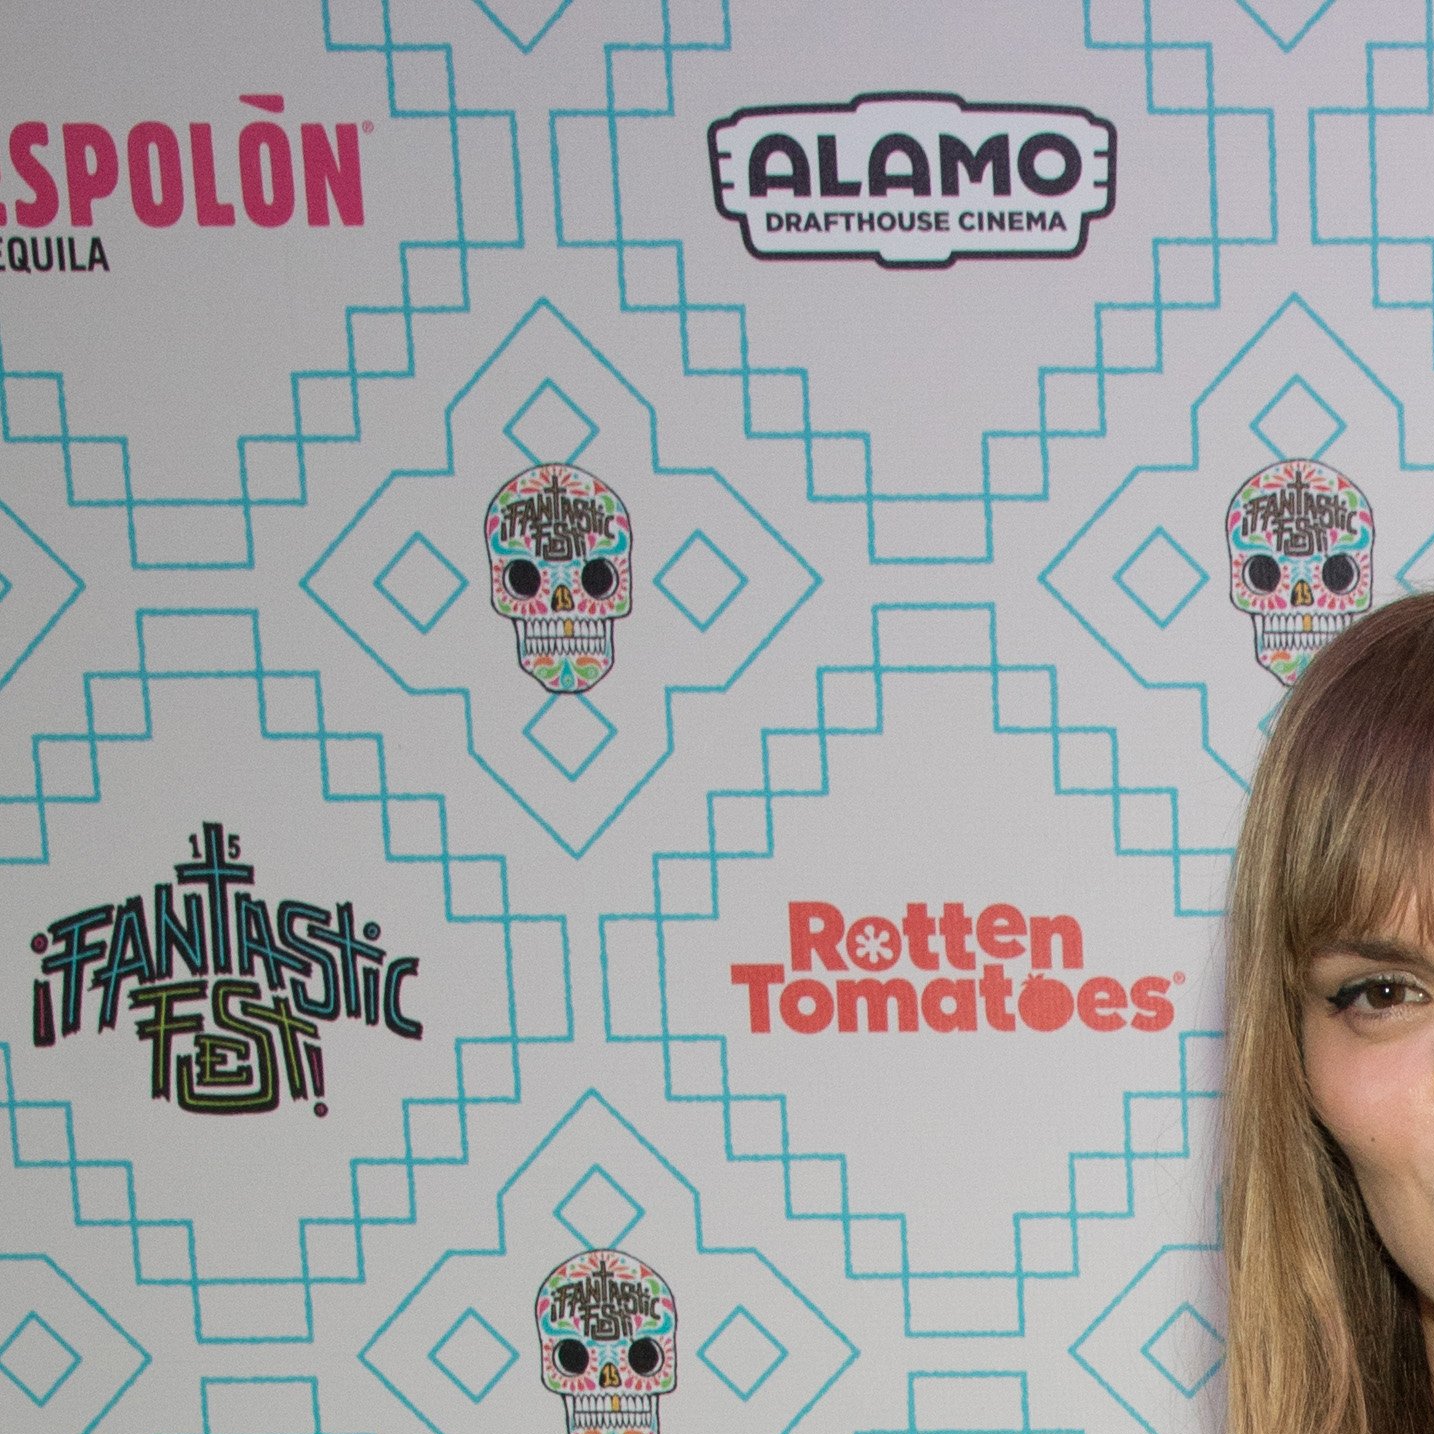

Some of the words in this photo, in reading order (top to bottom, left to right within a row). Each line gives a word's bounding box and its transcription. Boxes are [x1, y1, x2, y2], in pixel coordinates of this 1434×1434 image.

[0, 93, 365, 229] SPOLÒN
[749, 133, 1082, 197] ALAMO
[766, 212, 951, 232] DRAFTHOUSE
[959, 212, 1067, 232] CINEMA
[788, 901, 1084, 972] Rotten
[730, 963, 1175, 1035] Tomatoes
